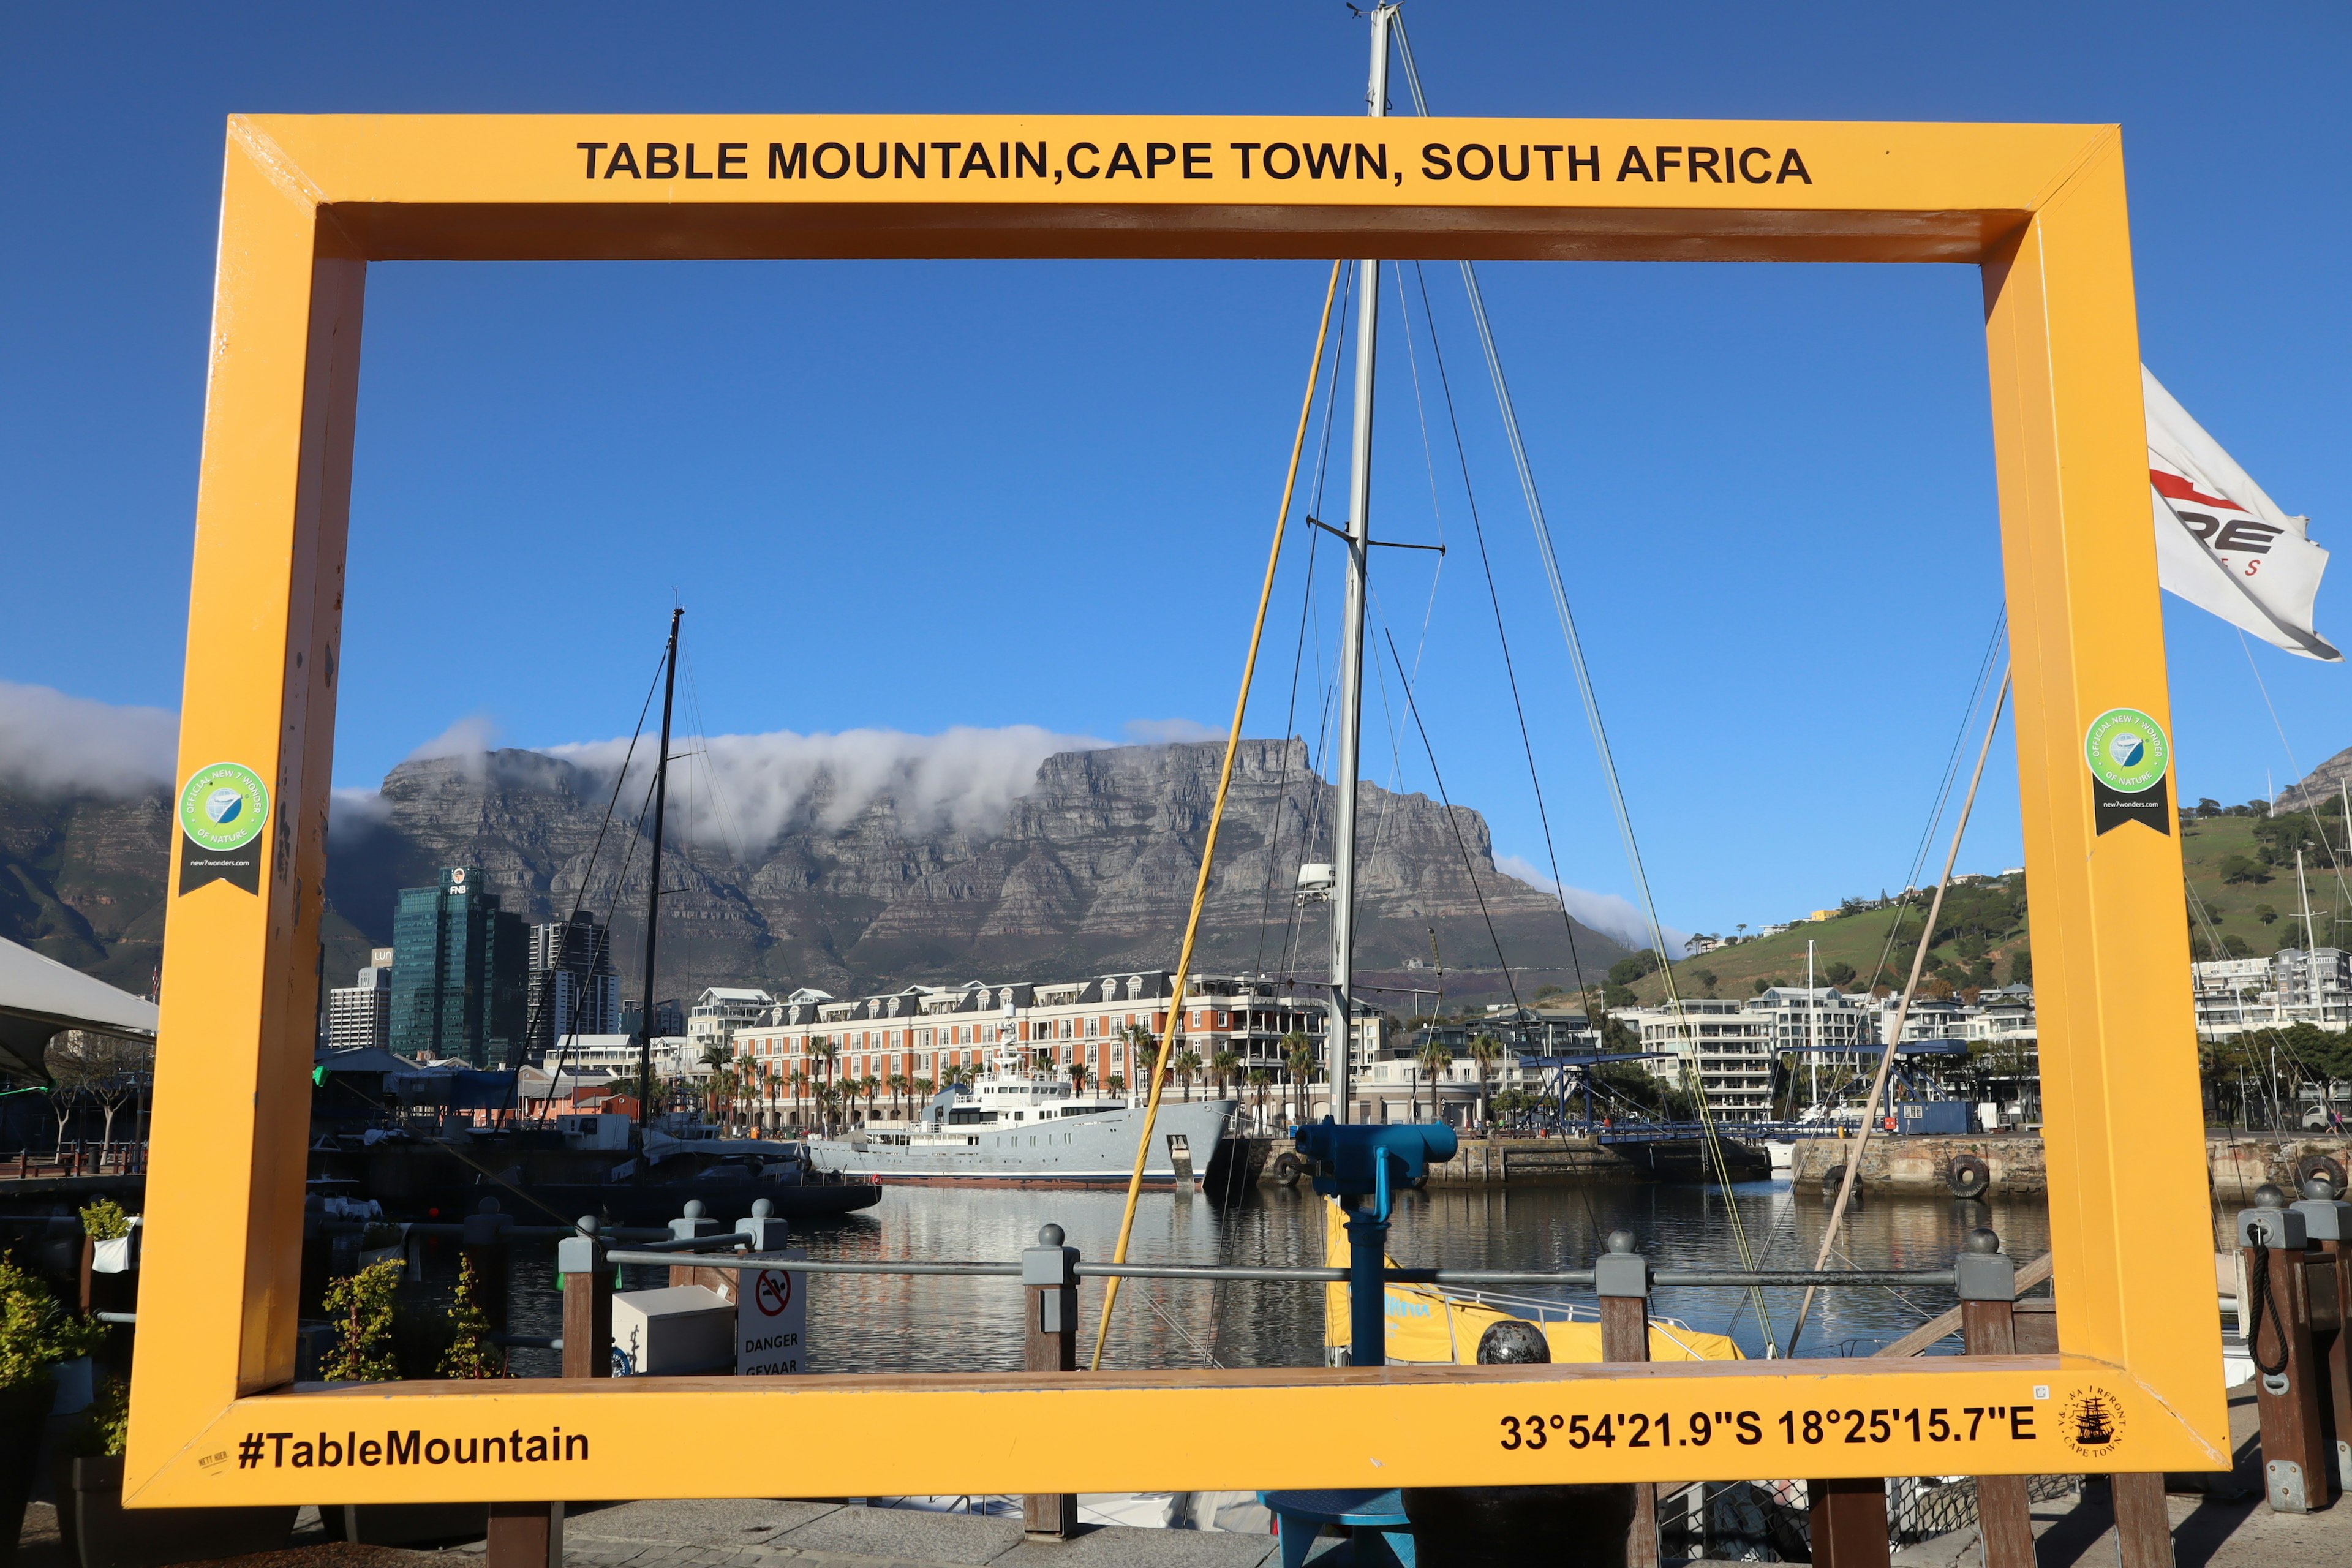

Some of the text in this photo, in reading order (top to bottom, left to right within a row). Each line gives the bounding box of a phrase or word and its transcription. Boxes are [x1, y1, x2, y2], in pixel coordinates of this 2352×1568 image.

[577, 143, 748, 179] TABLE
[1230, 142, 1403, 187] TOWN,
[1422, 143, 1600, 181] SOUTH
[1616, 146, 1812, 184] AFRICA
[2092, 720, 2112, 757] OFFICIAL
[2112, 715, 2132, 725] NEW
[2141, 721, 2163, 758] WONDER
[2106, 771, 2152, 786] OF NATURE
[187, 775, 212, 814] OFFICIAL
[212, 769, 234, 780] NEW
[243, 775, 262, 814] WONDER
[197, 828, 247, 843] OF NATURE
[450, 885, 466, 895] FNB
[375, 951, 393, 960] LUN
[745, 1333, 798, 1353] DANGER
[2058, 1404, 2068, 1426] V&
[1501, 1406, 2037, 1450] 33°54'21.9"S 18°25'15.7"E
[238, 1426, 588, 1469] #TableMountain
[2064, 1436, 2122, 1458] CAPE TOWN
